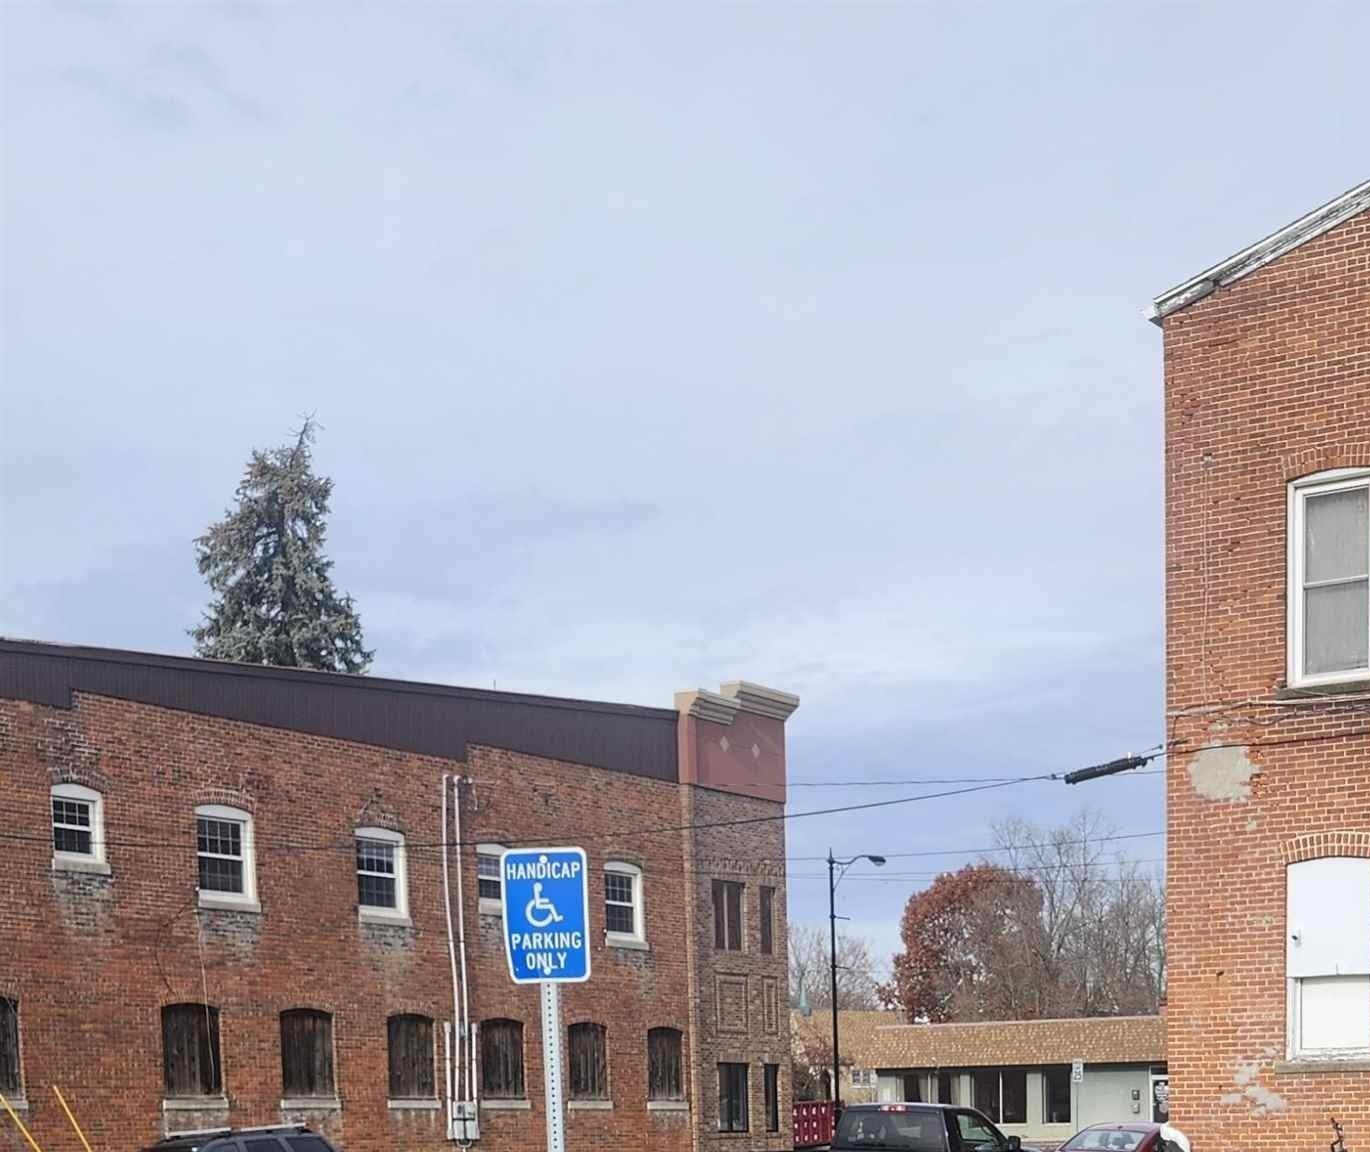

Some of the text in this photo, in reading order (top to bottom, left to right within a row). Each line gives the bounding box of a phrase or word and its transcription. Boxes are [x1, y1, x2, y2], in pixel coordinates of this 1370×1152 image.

[506, 861, 581, 880] HANDICAP
[511, 931, 582, 950] PARKING
[526, 952, 568, 970] ONLY
